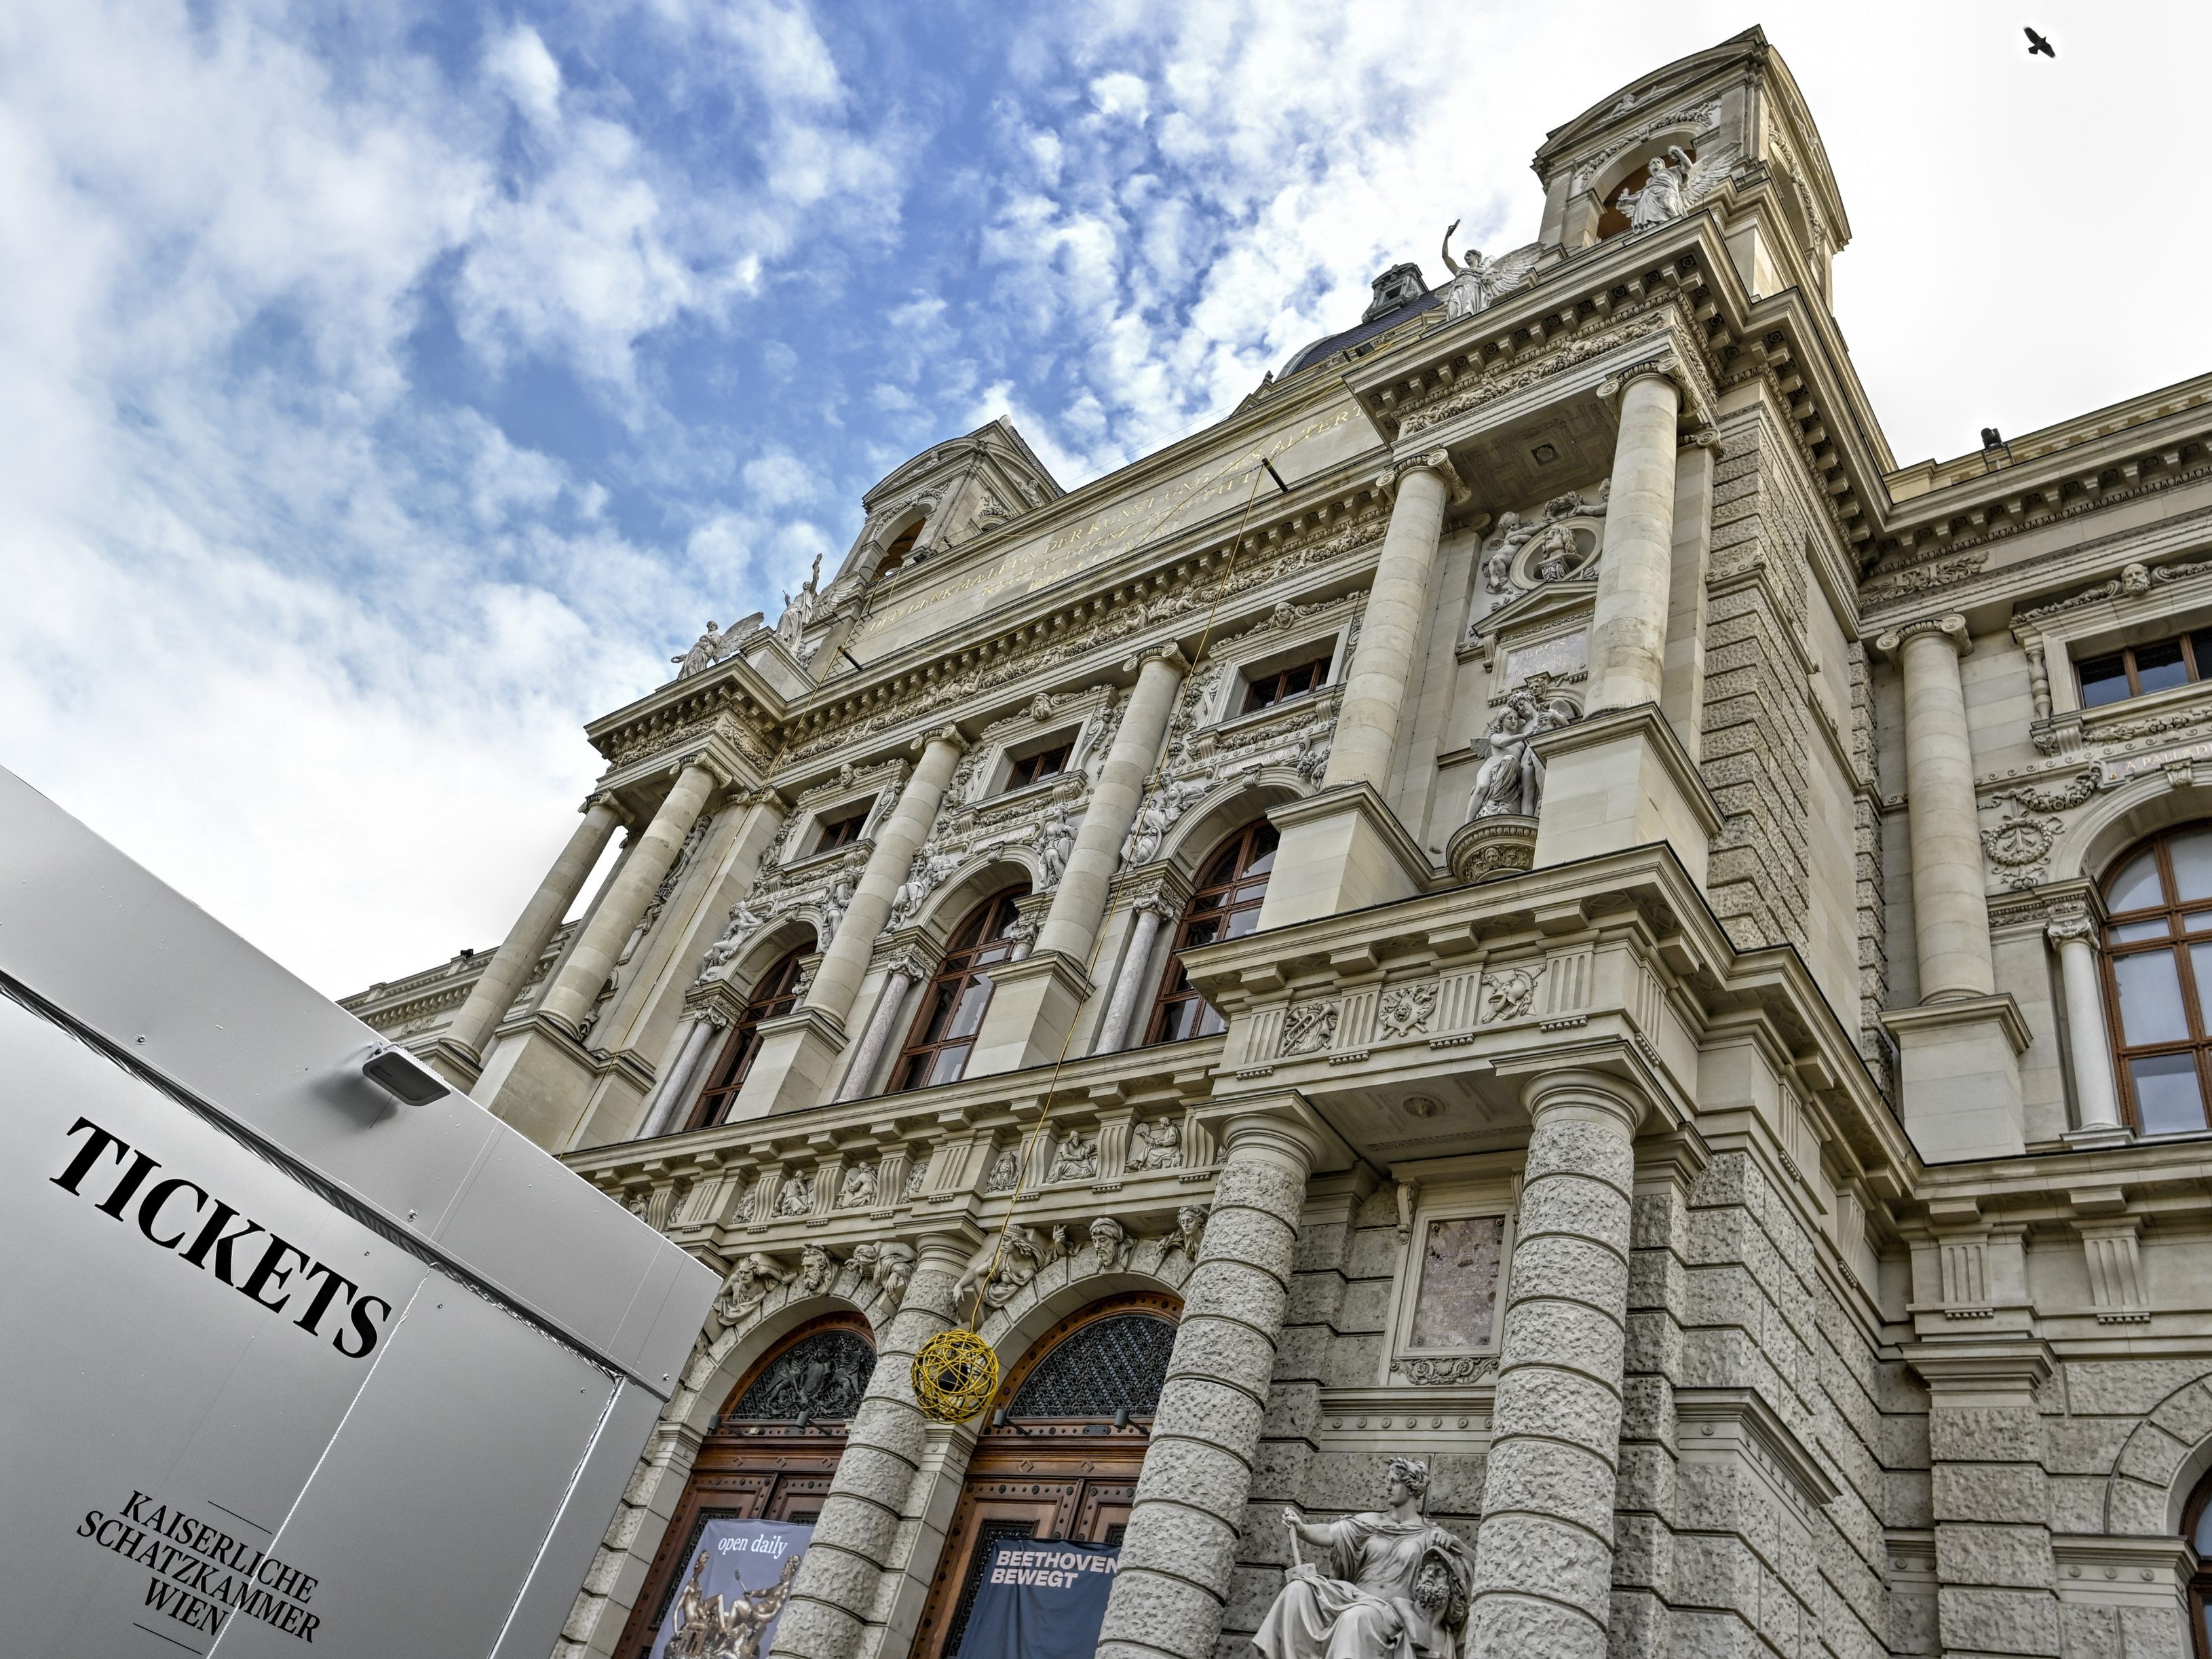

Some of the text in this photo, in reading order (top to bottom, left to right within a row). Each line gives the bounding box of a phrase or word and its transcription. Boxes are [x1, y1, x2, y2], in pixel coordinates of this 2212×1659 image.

[1044, 528, 1082, 554] DER
[1088, 497, 1155, 535] KUNST
[1165, 473, 1211, 500] UND
[50, 1116, 392, 1358] TICKETS
[76, 1510, 320, 1643] SCHATZKAMMER
[119, 1489, 319, 1604] KAISERLICHE
[717, 1533, 788, 1559] open daily
[990, 1567, 1079, 1588] BEWEGT
[996, 1550, 1118, 1574] BEETHOVEN
[145, 1576, 229, 1636] WIEN
